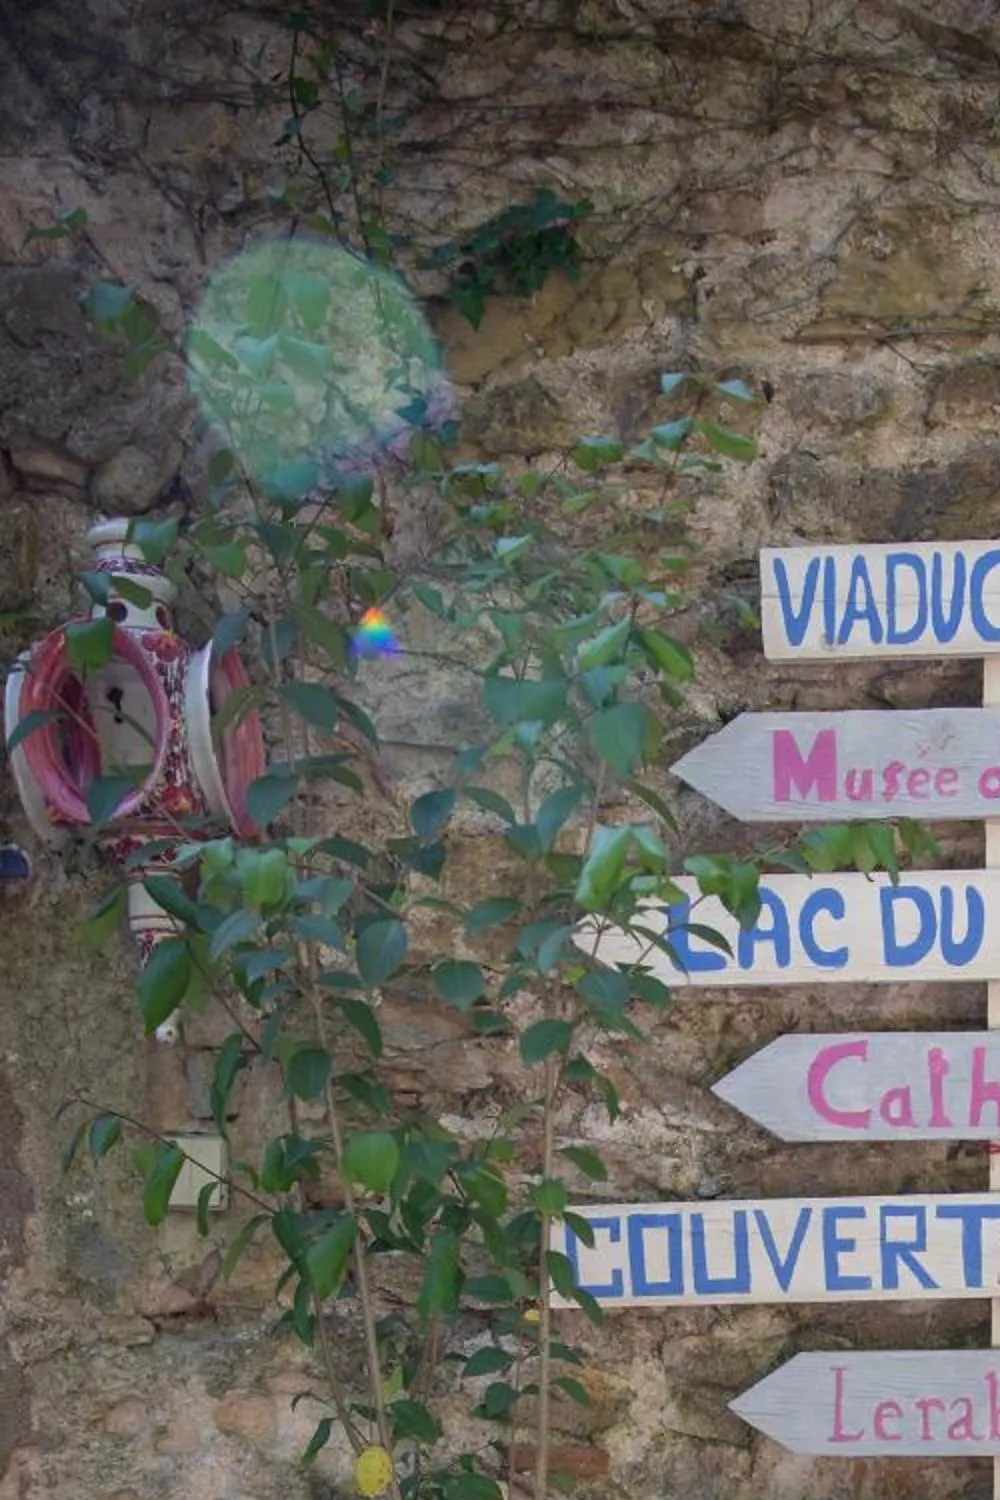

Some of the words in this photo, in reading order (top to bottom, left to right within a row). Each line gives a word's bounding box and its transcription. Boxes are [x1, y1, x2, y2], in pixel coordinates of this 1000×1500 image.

[772, 727, 959, 803] Musée
[667, 886, 850, 973] LAC
[880, 885, 985, 968] DU
